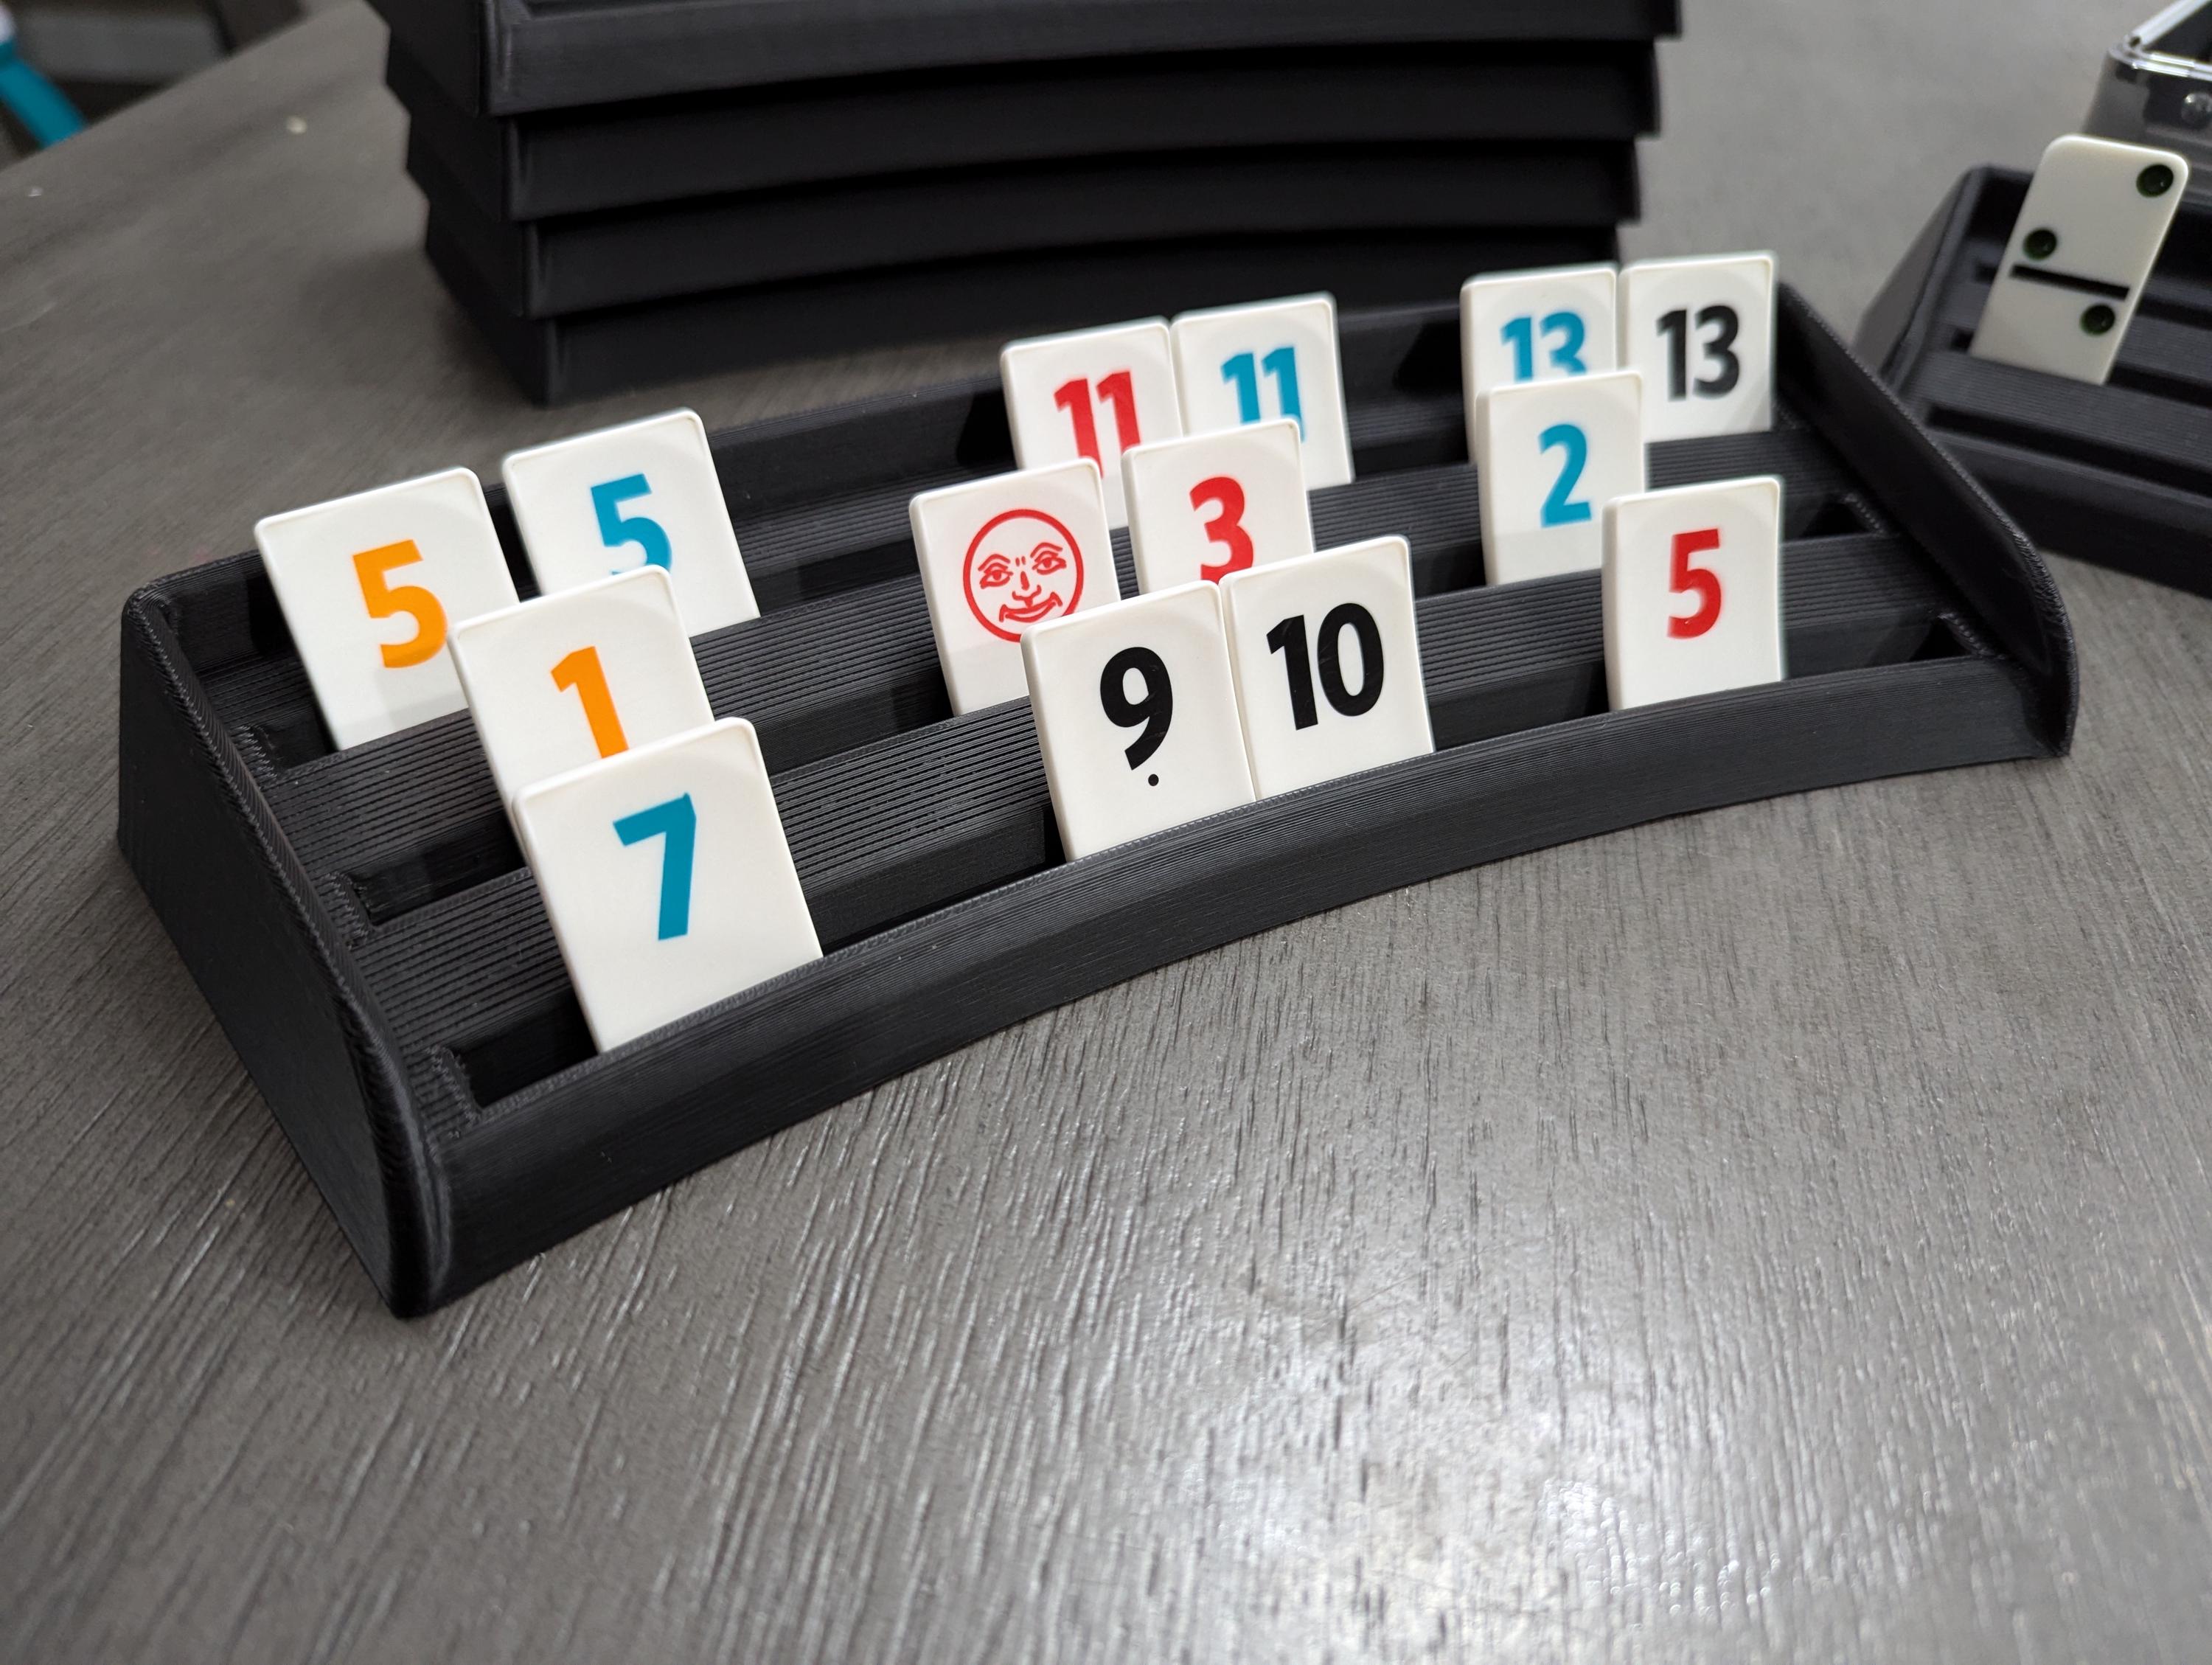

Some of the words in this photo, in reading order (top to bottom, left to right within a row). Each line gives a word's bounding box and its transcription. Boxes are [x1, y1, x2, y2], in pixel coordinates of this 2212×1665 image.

[1220, 344, 1307, 442] 11
[1500, 307, 1587, 383] 13
[1655, 303, 1741, 401] 13
[1054, 369, 1141, 478] 11
[1538, 422, 1593, 528] 2
[589, 473, 672, 575] 5
[1189, 476, 1255, 585] 3
[352, 539, 449, 670] 5
[1666, 528, 1724, 639] 5
[550, 646, 629, 759] 1
[1267, 603, 1385, 731] 10
[613, 792, 697, 941] 7
